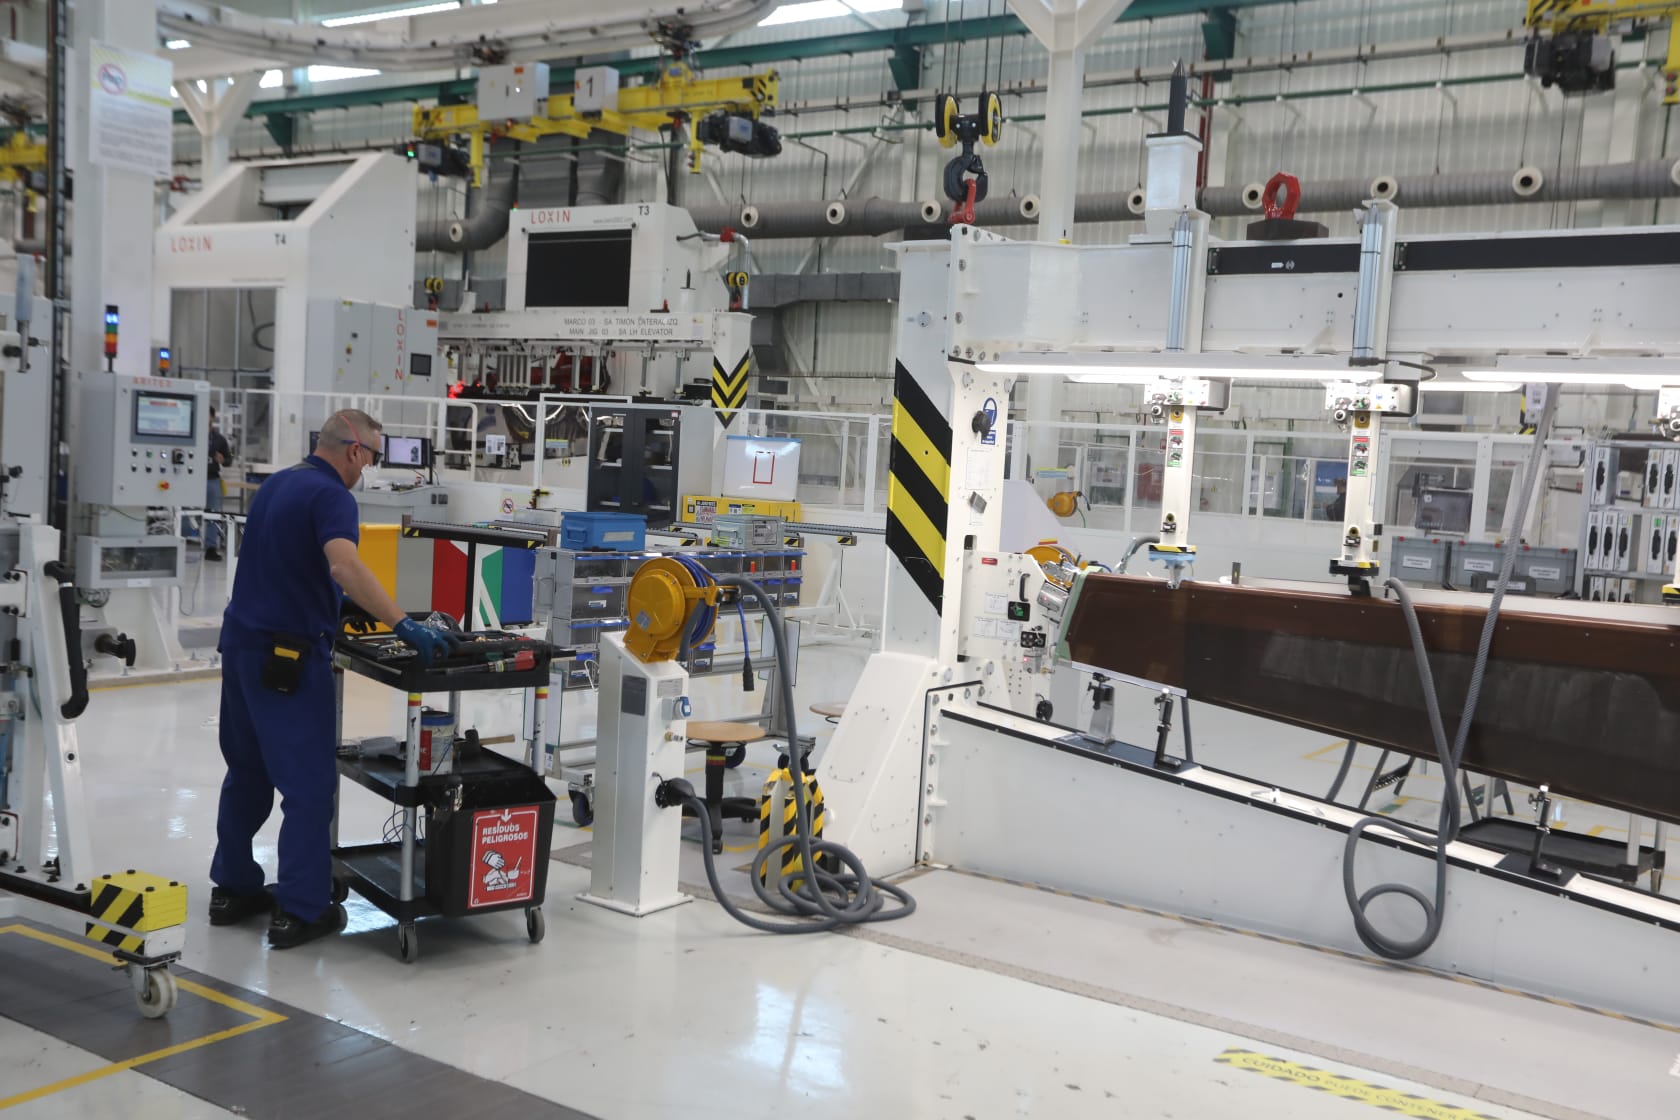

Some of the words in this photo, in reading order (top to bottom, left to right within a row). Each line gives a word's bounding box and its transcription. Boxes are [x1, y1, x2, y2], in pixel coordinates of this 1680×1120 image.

[530, 209, 571, 224] LOXIN
[638, 205, 650, 216] T3
[170, 236, 212, 253] LOXIN
[274, 233, 287, 246] T4
[640, 327, 673, 336] ELEVATOR
[481, 831, 529, 845] PELIGROSOS
[1242, 1057, 1321, 1082] CUIDADO
